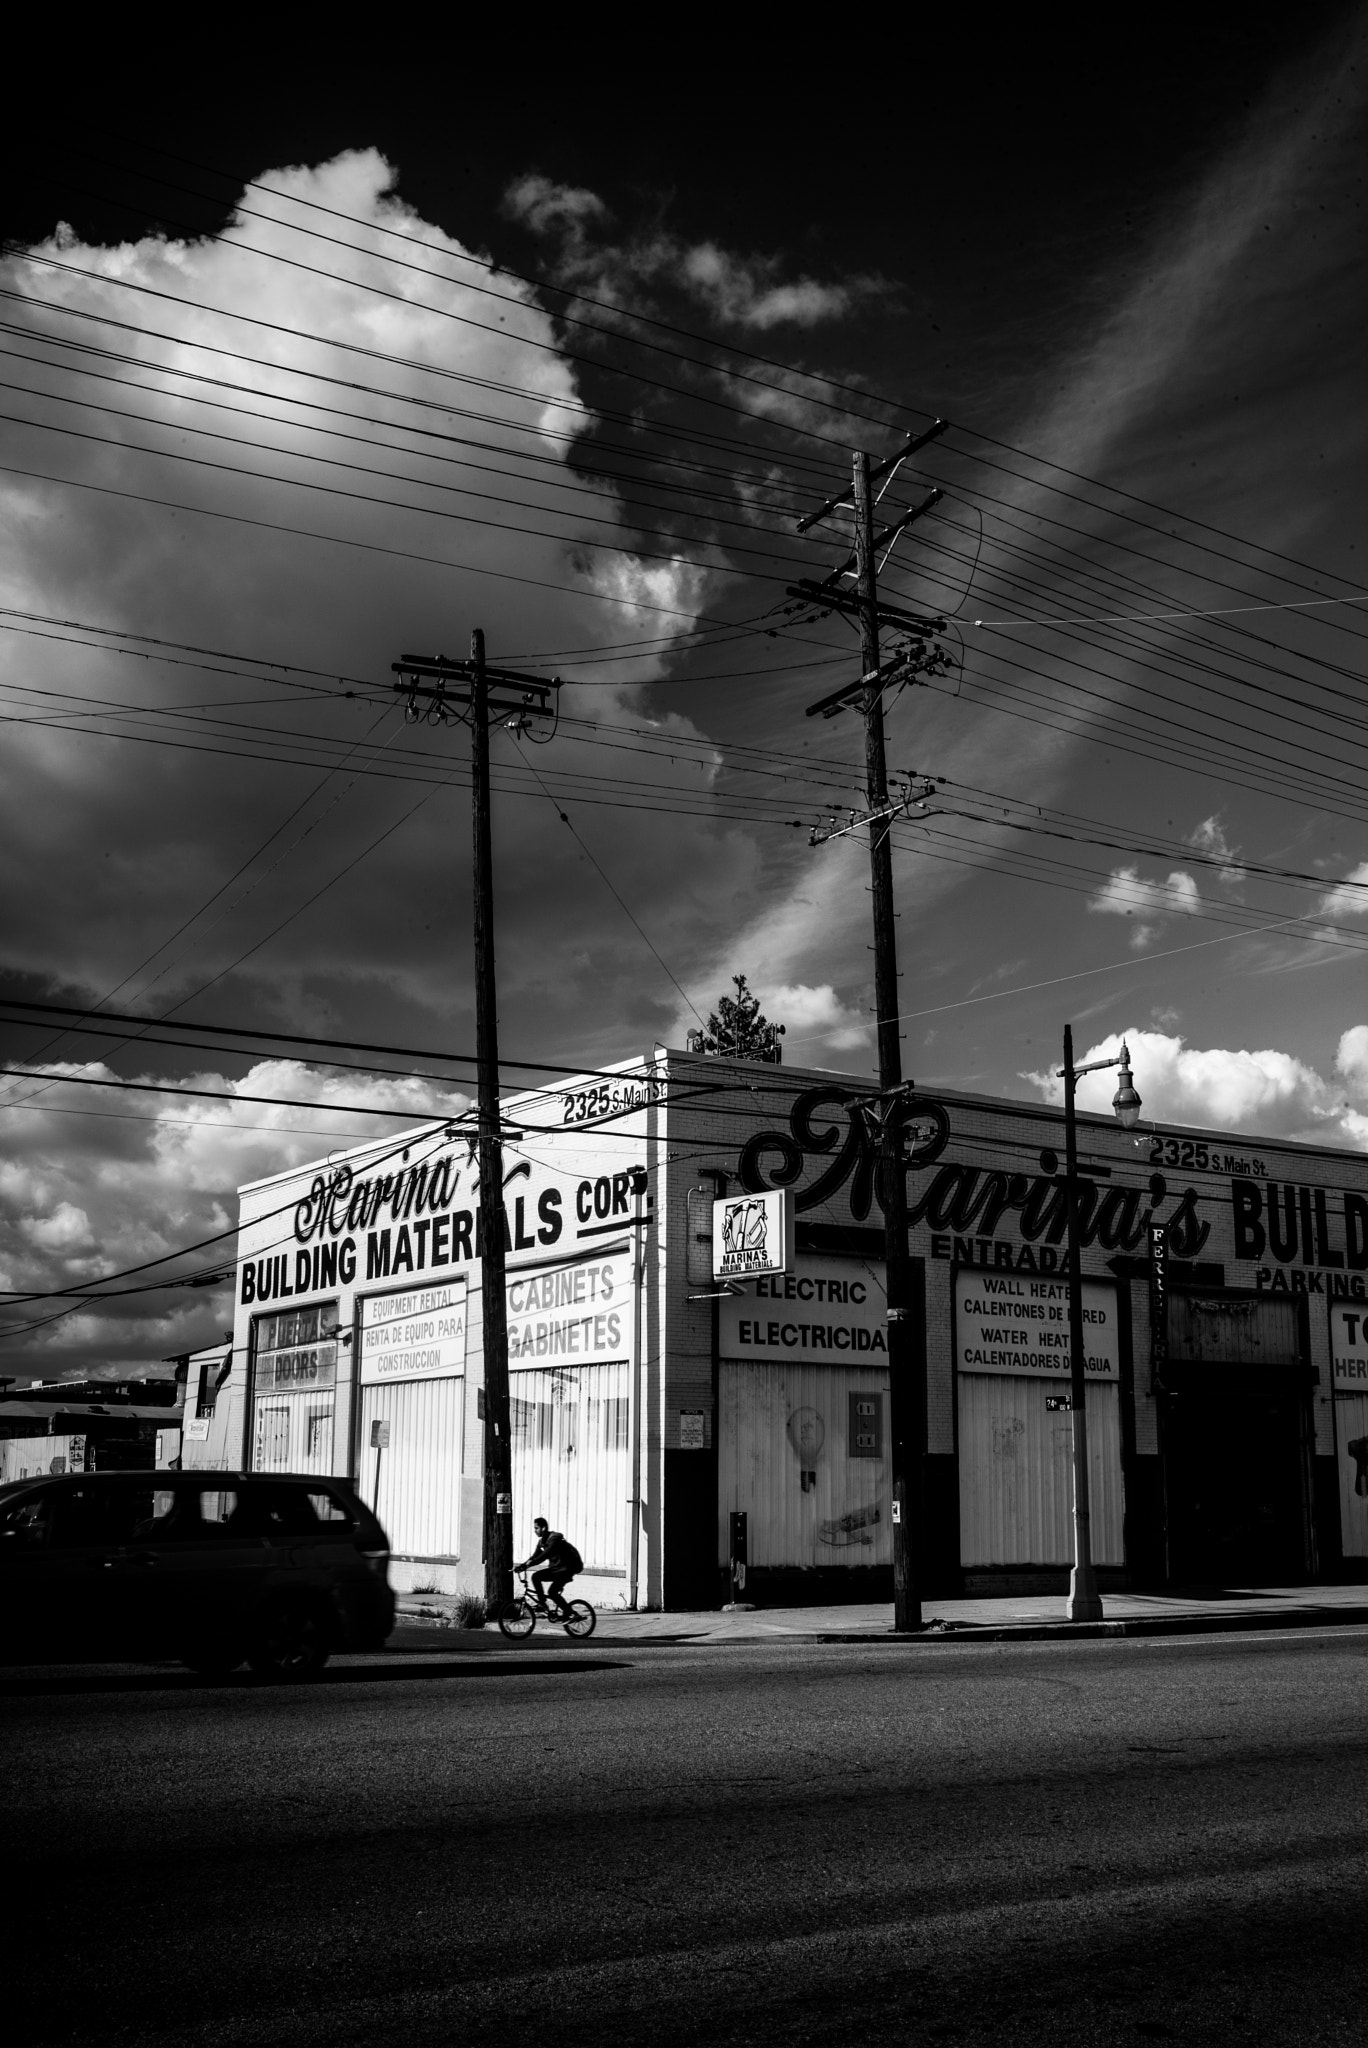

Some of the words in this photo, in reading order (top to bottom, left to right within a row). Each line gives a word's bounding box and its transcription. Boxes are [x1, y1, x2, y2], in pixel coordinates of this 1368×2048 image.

[564, 1084, 610, 1124] 2325
[624, 1085, 651, 1107] Main
[1149, 1138, 1209, 1168] 2325
[1212, 1156, 1223, 1171] S.
[1224, 1157, 1250, 1174] Main
[1252, 1160, 1269, 1176] St.
[294, 1148, 531, 1244] Marina'
[1231, 1179, 1368, 1270] BUILD
[241, 1236, 356, 1304] BUILDING
[366, 1187, 563, 1280] MATERILS
[723, 1249, 768, 1266] MARINA'S
[720, 1264, 742, 1273] BUILDING
[744, 1259, 774, 1270] MATERIALS
[509, 1264, 614, 1312] CABINETS
[756, 1275, 866, 1304] ELECTRIC
[983, 1279, 1025, 1296] WALL
[1256, 1267, 1366, 1298] PARKING
[373, 1295, 417, 1320] EQUIPMENT
[420, 1289, 454, 1311] RENTAL
[964, 1299, 1045, 1320] CALENTONES
[1049, 1306, 1063, 1321] DE
[268, 1314, 329, 1348] PUERTAS
[366, 1329, 390, 1347] RENTA
[392, 1326, 402, 1343] DE
[405, 1322, 434, 1345] EQUIPO
[438, 1316, 463, 1336] PARA
[508, 1313, 621, 1359] GABINETES
[981, 1327, 1028, 1345] WATER
[275, 1351, 318, 1381] DOORS
[377, 1349, 441, 1373] CONSTRUCCION
[964, 1348, 1060, 1369] CALENTADORES
[1082, 1356, 1111, 1372] AGUA
